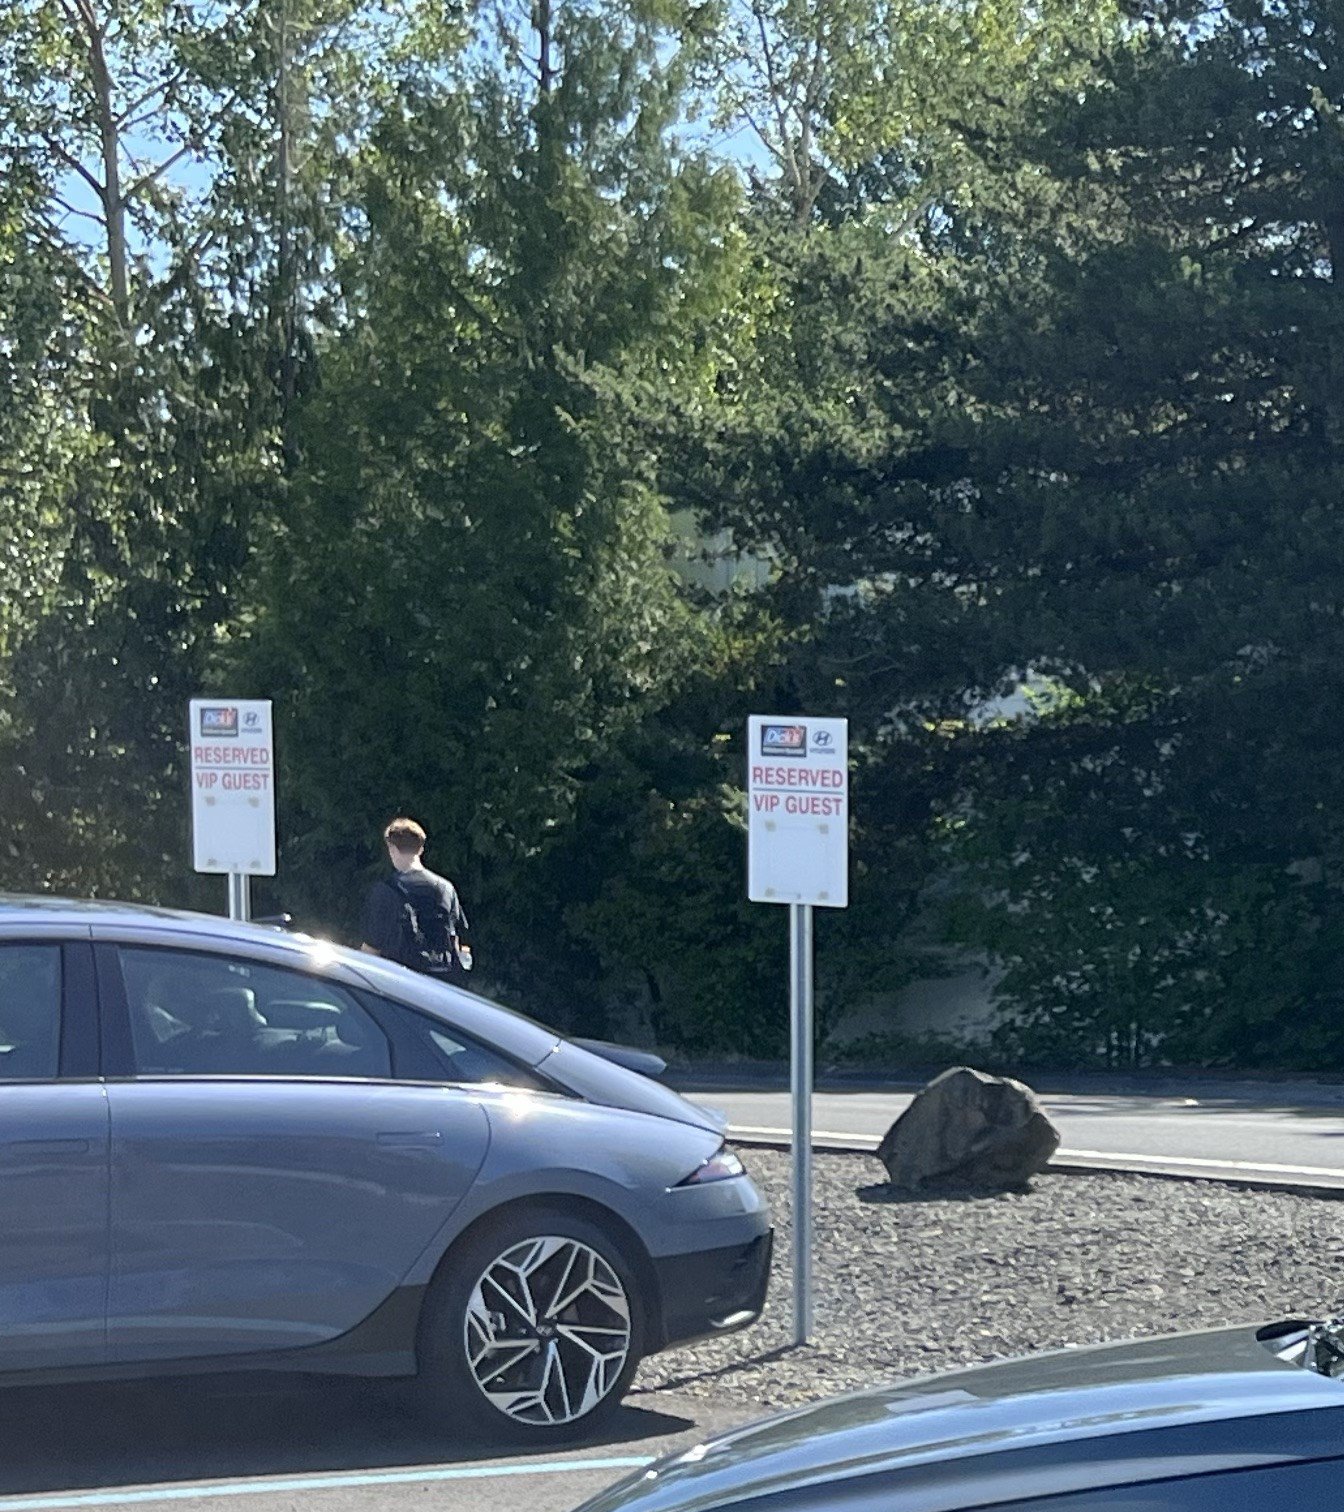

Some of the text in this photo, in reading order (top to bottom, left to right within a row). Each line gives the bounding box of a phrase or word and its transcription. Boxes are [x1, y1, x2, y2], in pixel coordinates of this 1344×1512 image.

[194, 747, 270, 764] RESERVED
[196, 772, 270, 790] VIP GUEST
[752, 766, 844, 788] RESERVED
[754, 794, 843, 816] VIP GUEST
